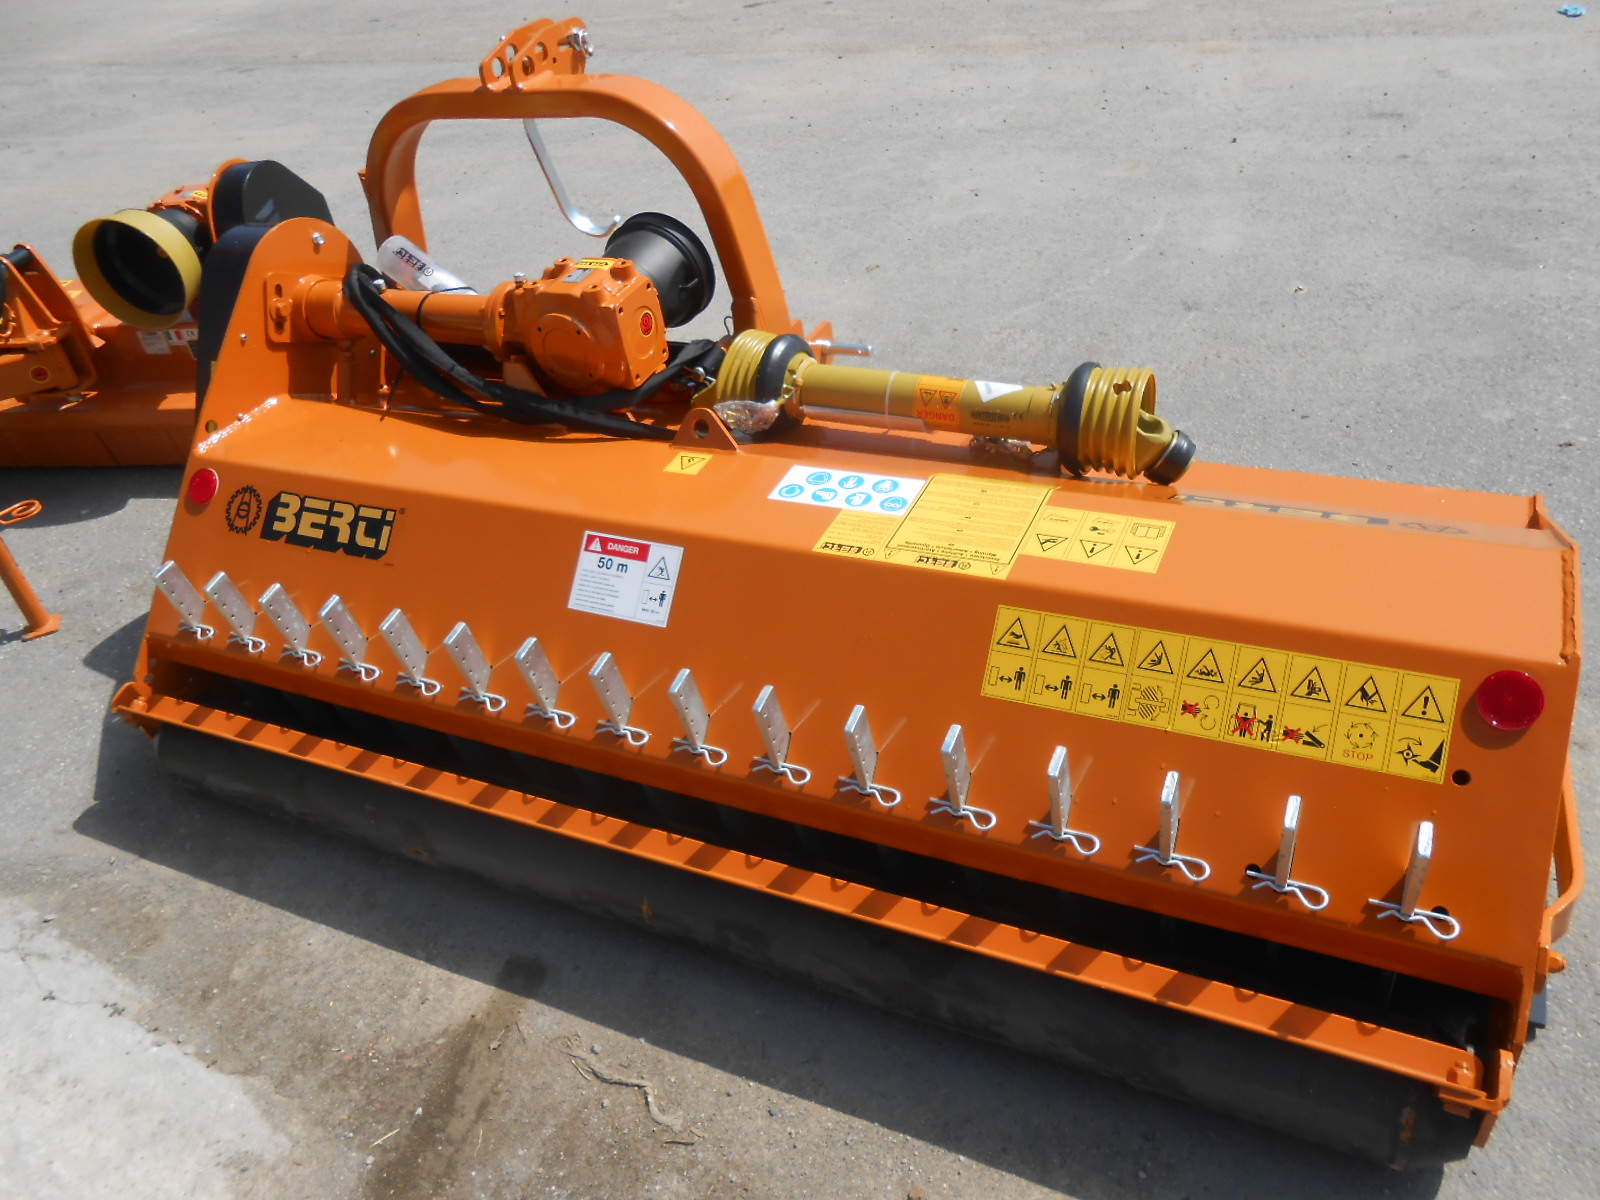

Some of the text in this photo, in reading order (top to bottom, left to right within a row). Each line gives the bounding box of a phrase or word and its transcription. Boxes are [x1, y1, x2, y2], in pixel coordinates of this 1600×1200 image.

[916, 409, 956, 422] DANGER
[607, 542, 640, 555] DANGER
[597, 556, 628, 573] 50 m
[1342, 748, 1374, 762] STOP
